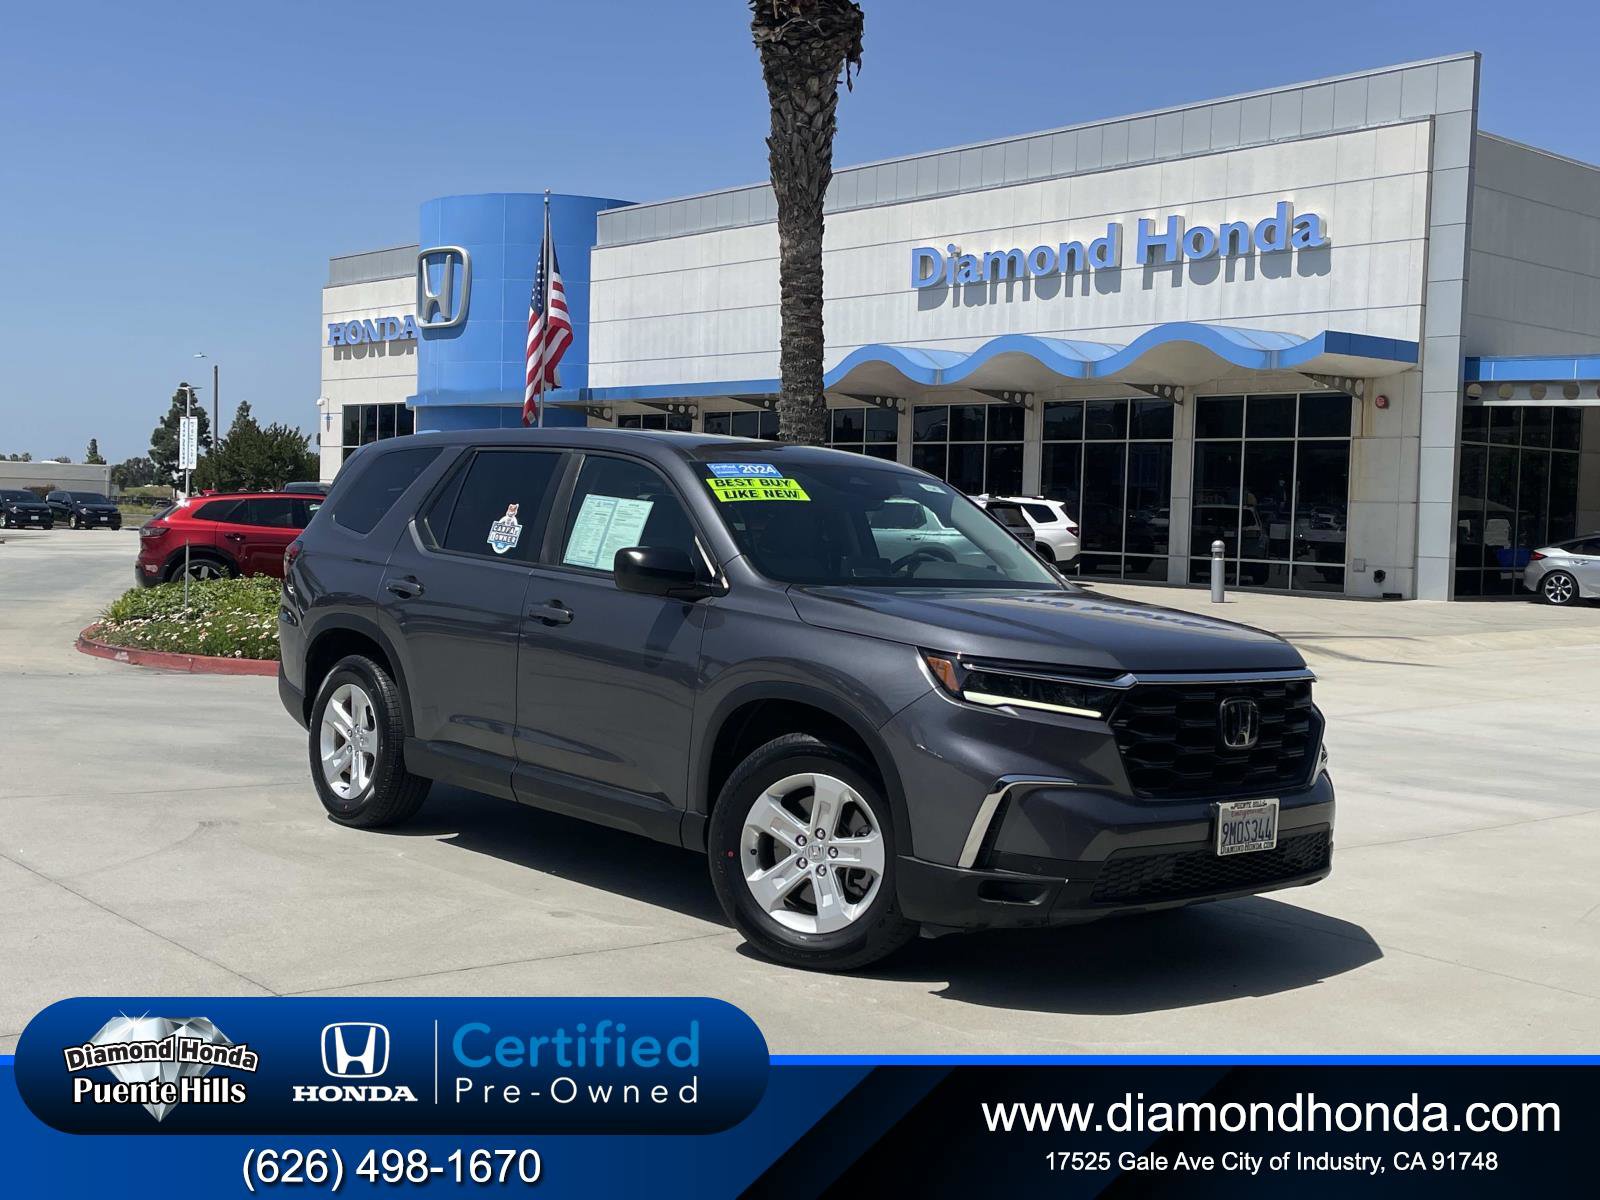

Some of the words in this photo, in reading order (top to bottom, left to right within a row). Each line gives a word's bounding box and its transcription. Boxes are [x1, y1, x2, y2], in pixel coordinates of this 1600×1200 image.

[912, 223, 1122, 289] Diamond
[1136, 201, 1330, 265] Honda
[328, 315, 418, 346] HONDA
[739, 465, 777, 474] 2024
[714, 479, 753, 487] BEST
[760, 479, 790, 487] BUY
[724, 490, 759, 499] LIKE
[764, 489, 798, 498] NEW
[1222, 816, 1272, 846] 9MOS344
